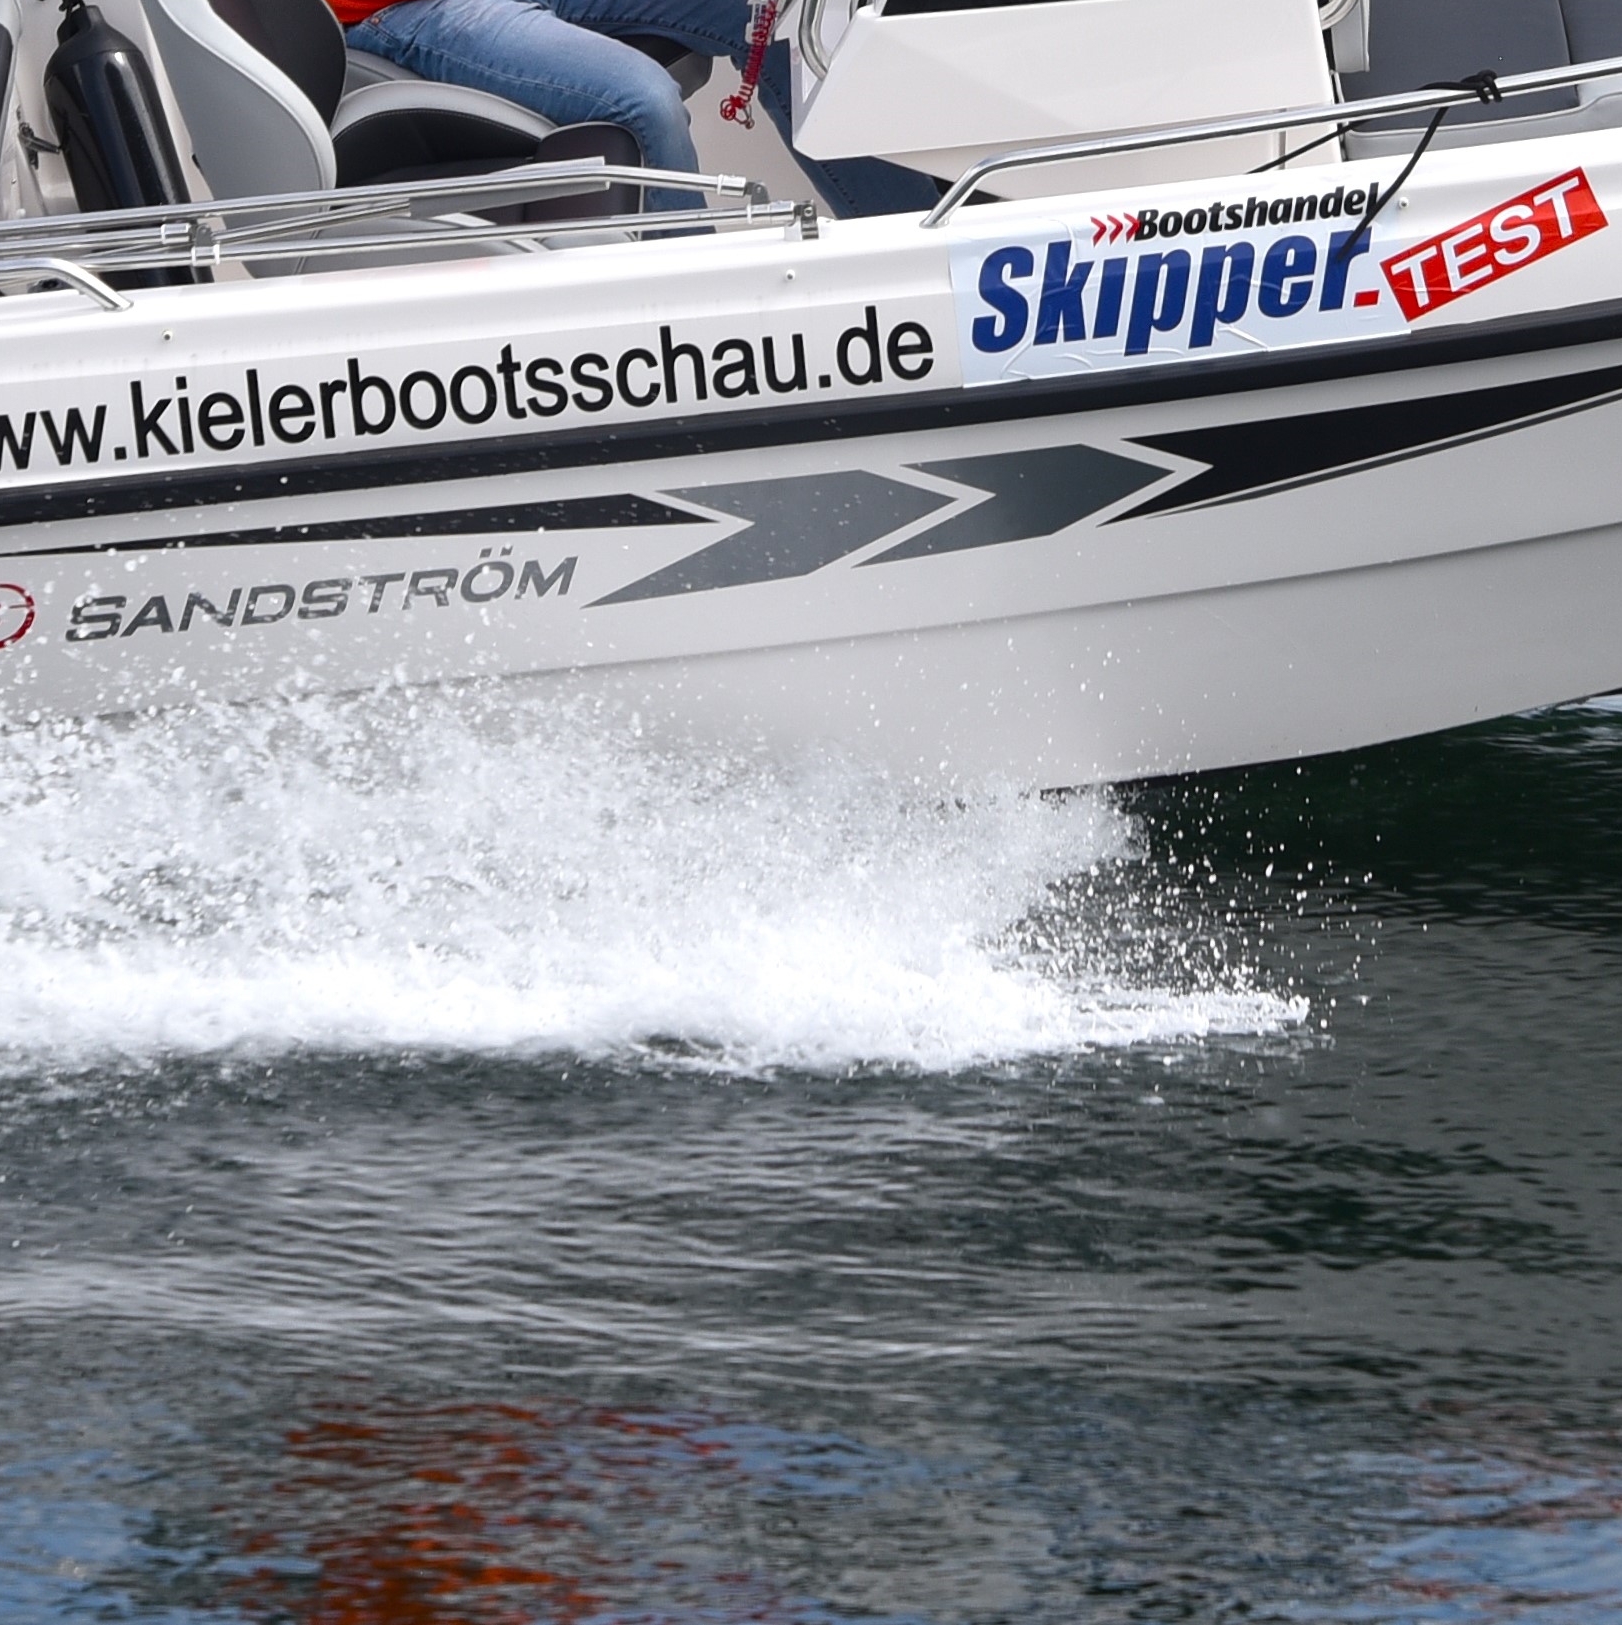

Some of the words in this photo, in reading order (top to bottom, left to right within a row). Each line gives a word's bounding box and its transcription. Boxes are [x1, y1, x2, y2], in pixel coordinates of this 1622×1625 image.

[1133, 182, 1379, 242] Bootshandel
[1390, 176, 1584, 308] TEST
[65, 547, 579, 643] SANDSTRÖM
